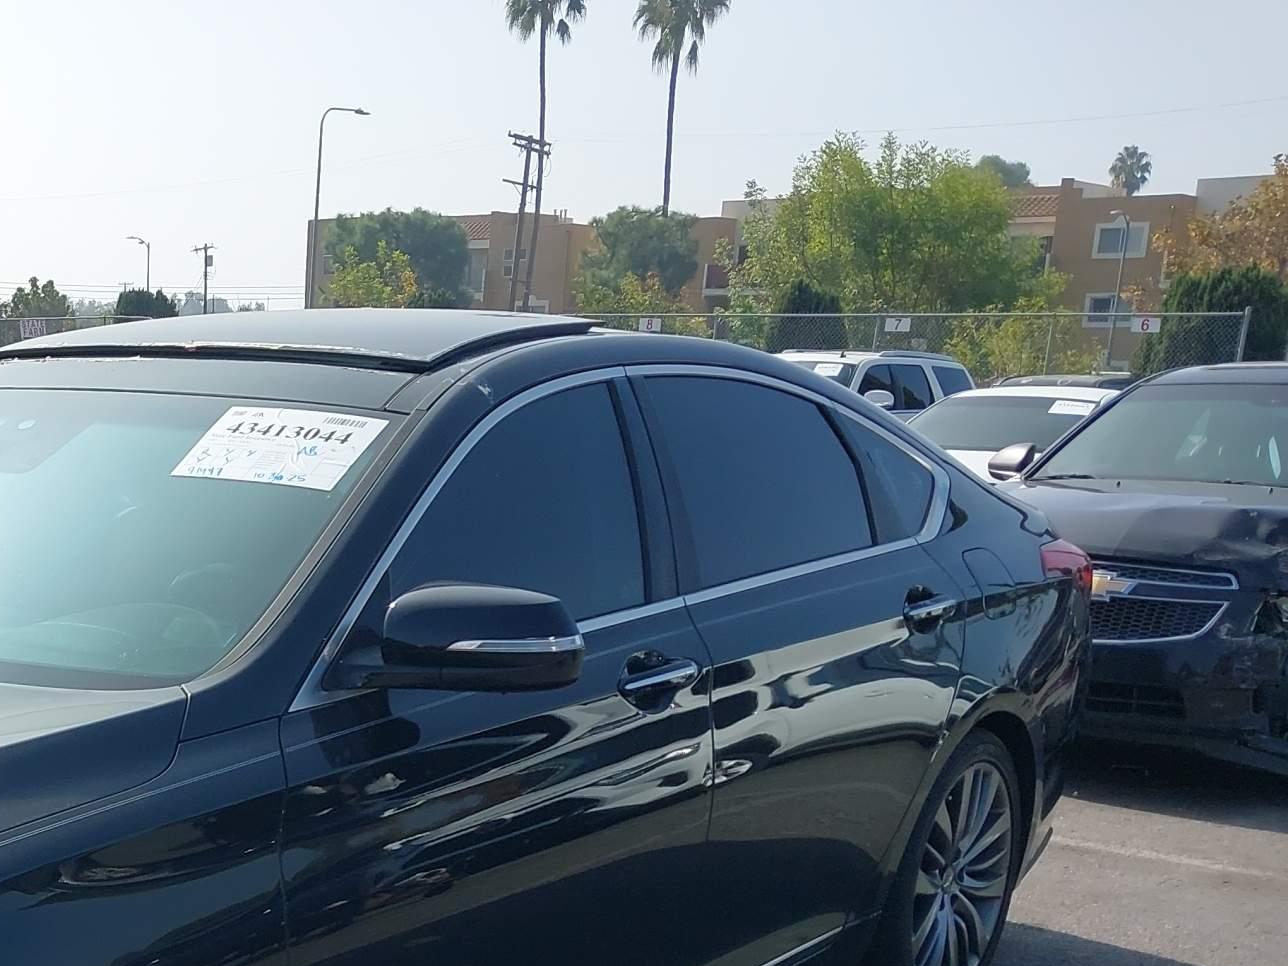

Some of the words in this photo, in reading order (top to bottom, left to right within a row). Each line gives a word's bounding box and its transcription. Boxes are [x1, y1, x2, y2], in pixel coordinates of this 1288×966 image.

[646, 319, 654, 330] 8
[895, 318, 903, 331] 7
[1140, 318, 1150, 332] 6
[23, 327, 45, 336] FARM
[226, 420, 354, 445] 43413044
